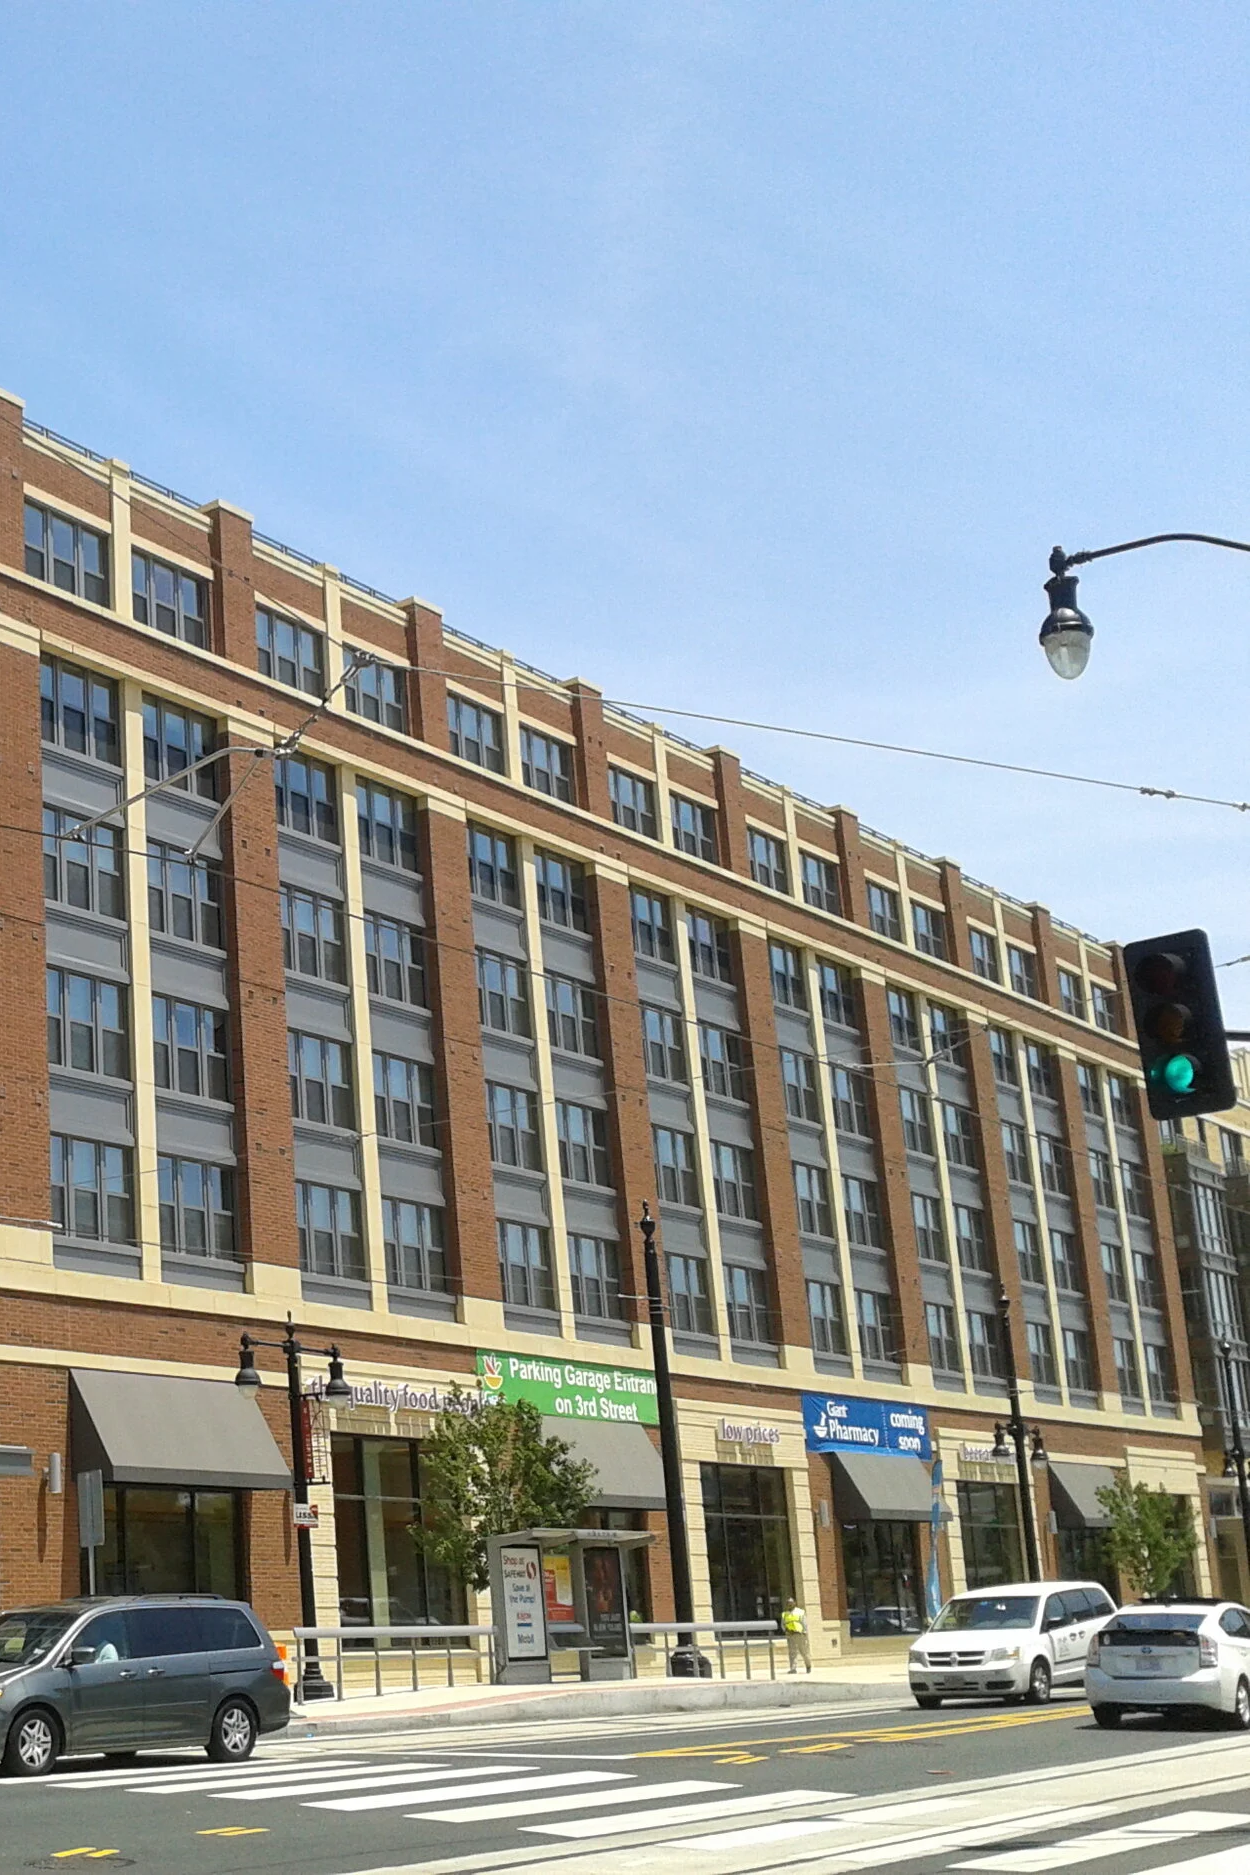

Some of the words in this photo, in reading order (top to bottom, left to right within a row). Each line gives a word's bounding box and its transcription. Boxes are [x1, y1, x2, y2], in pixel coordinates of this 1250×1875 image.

[508, 1356, 562, 1389] Parking
[564, 1364, 612, 1394] Garage
[613, 1370, 657, 1396] Entran
[402, 1383, 440, 1411] food
[555, 1396, 573, 1415] on
[575, 1394, 598, 1418] 3rd
[599, 1397, 639, 1422] Street
[825, 1400, 849, 1419] Giant
[720, 1416, 744, 1442] low
[743, 1421, 781, 1449] prices
[828, 1418, 880, 1447] Pharmacy
[889, 1408, 926, 1436] coming
[898, 1434, 922, 1452] soon
